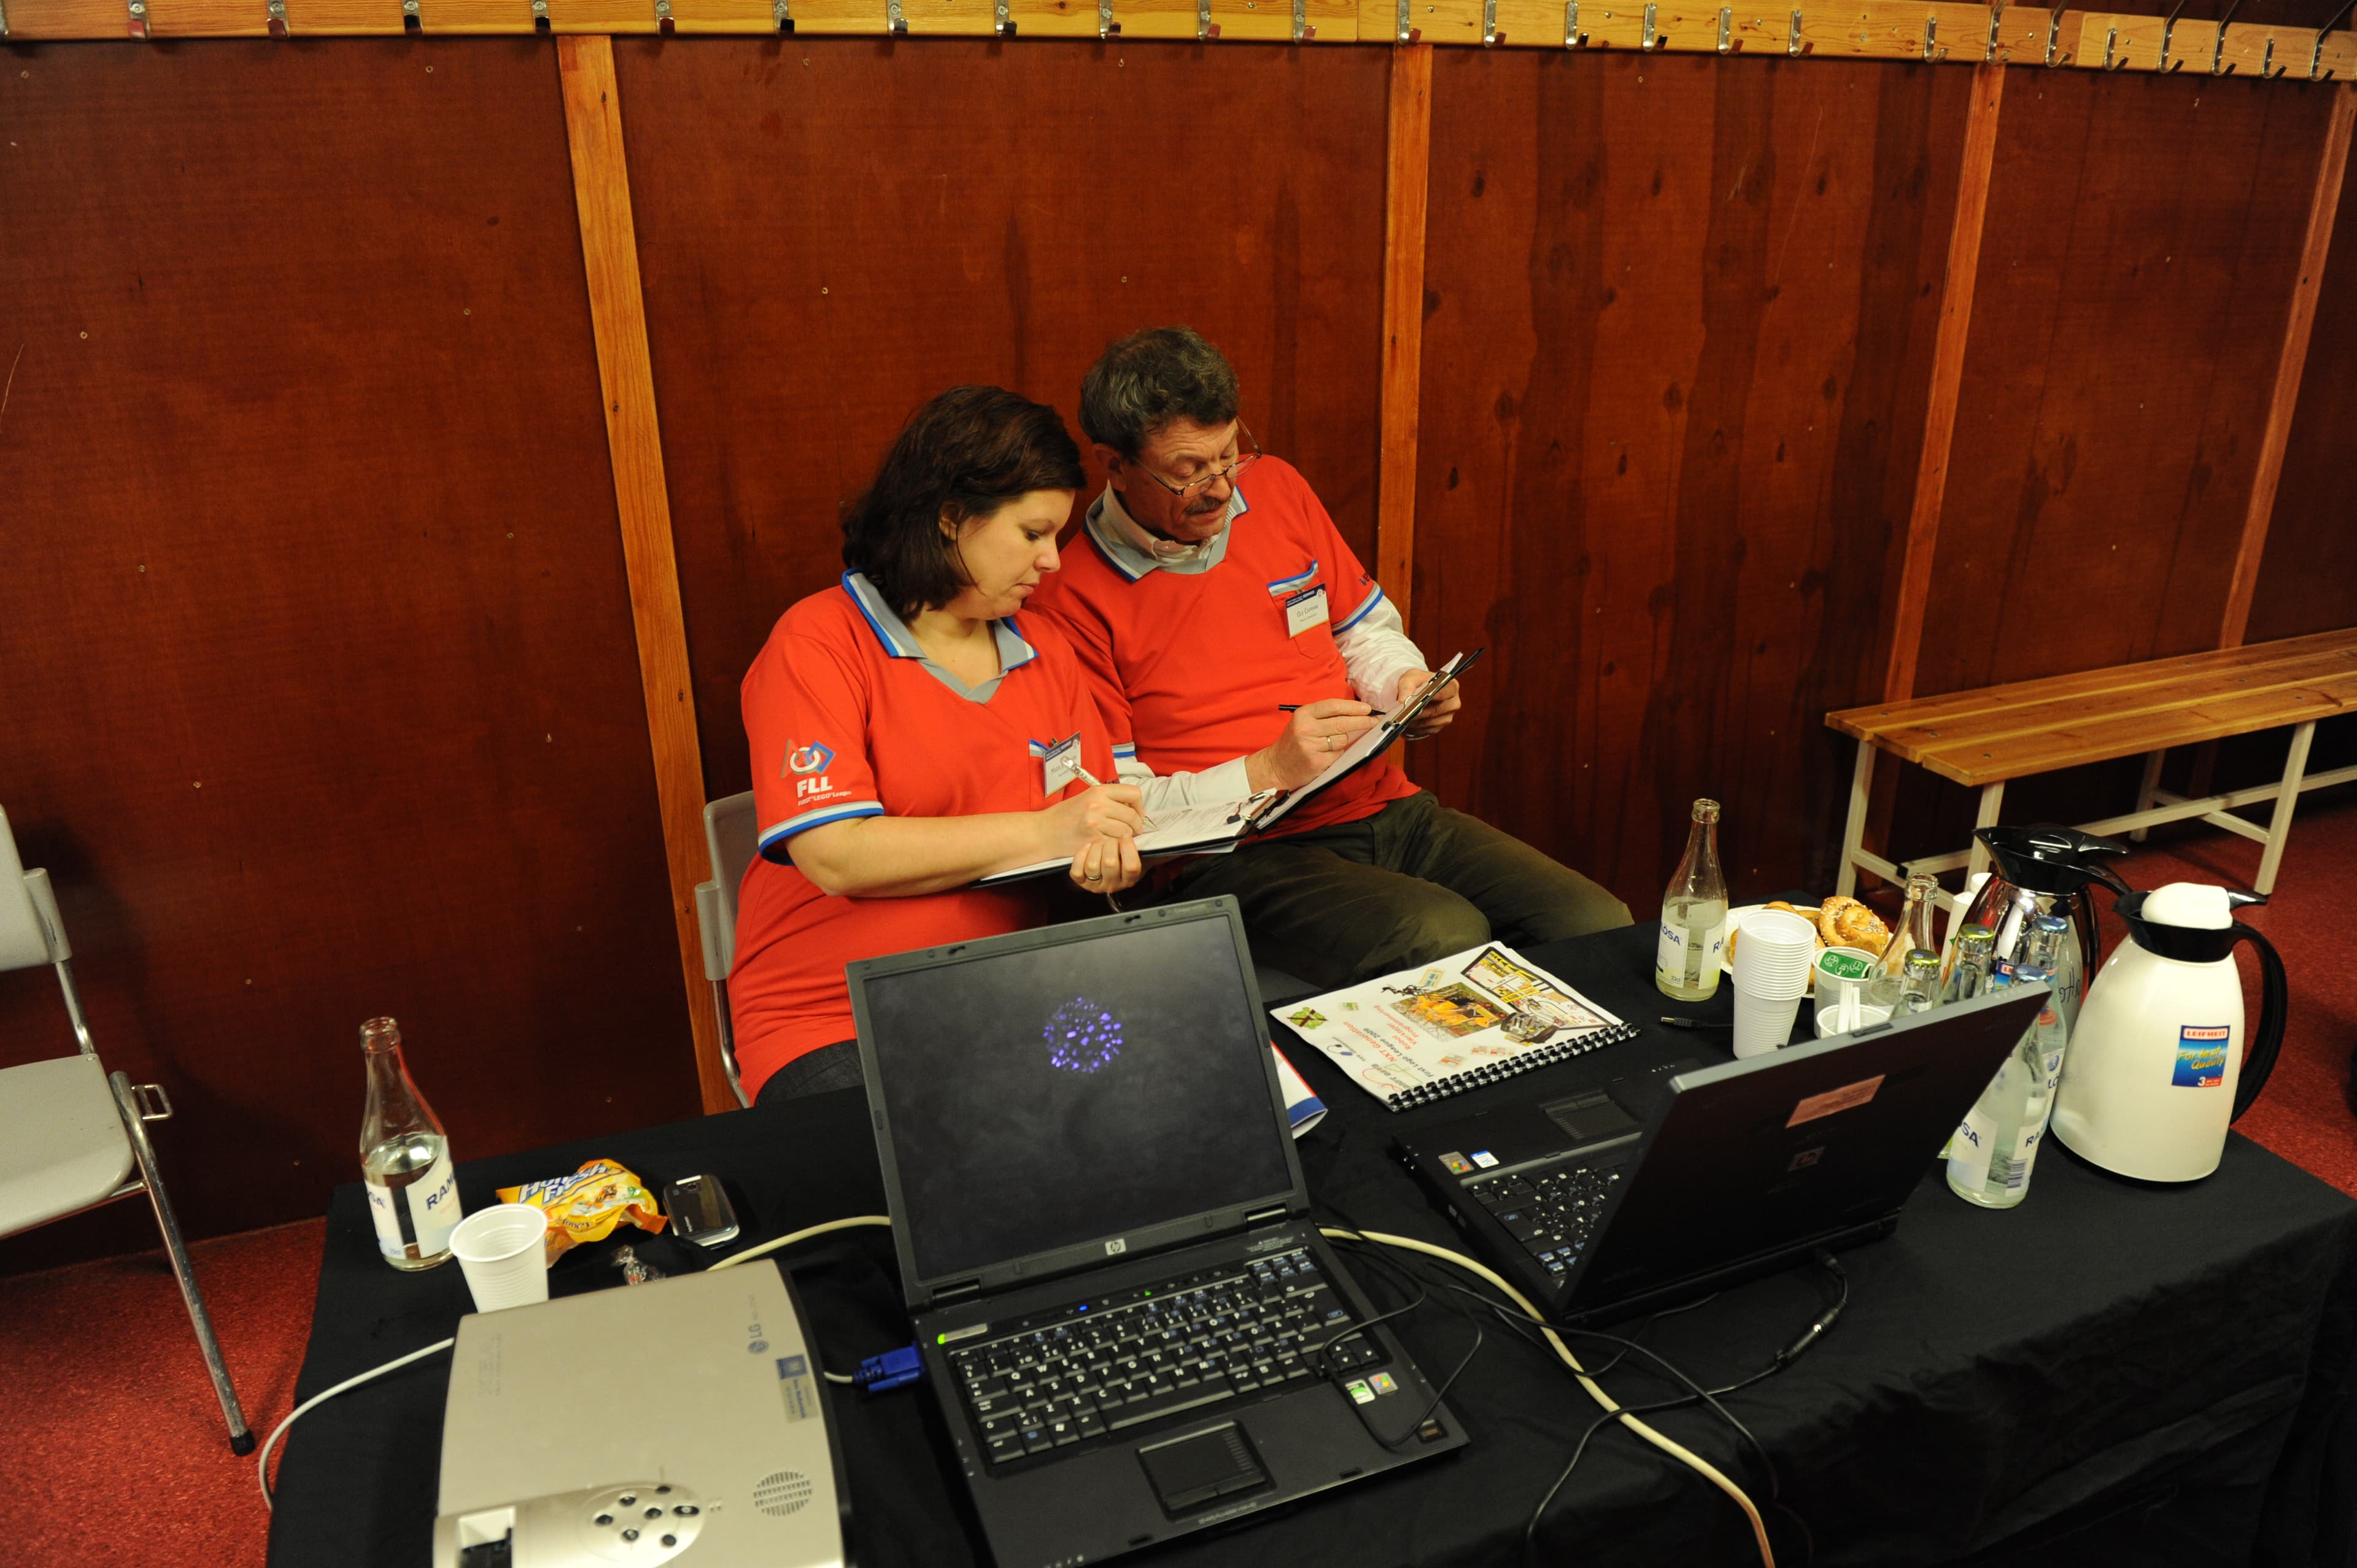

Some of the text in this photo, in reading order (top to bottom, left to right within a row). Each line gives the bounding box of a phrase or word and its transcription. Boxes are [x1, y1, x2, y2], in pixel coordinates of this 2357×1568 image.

[797, 776, 833, 798] FLL
[1374, 1005, 1419, 1038] Programmering
[1343, 1021, 1381, 1049] Generation
[1392, 1035, 1412, 1050] Robot
[1380, 1038, 1403, 1057] League
[2178, 1045, 2221, 1060] For best
[1379, 1049, 1397, 1062] NXT
[1402, 1056, 1418, 1068] Lego
[2191, 1055, 2224, 1070] Quality
[1417, 1066, 1434, 1078] First
[2197, 1076, 2206, 1086] 3
[748, 1323, 762, 1338] LG
